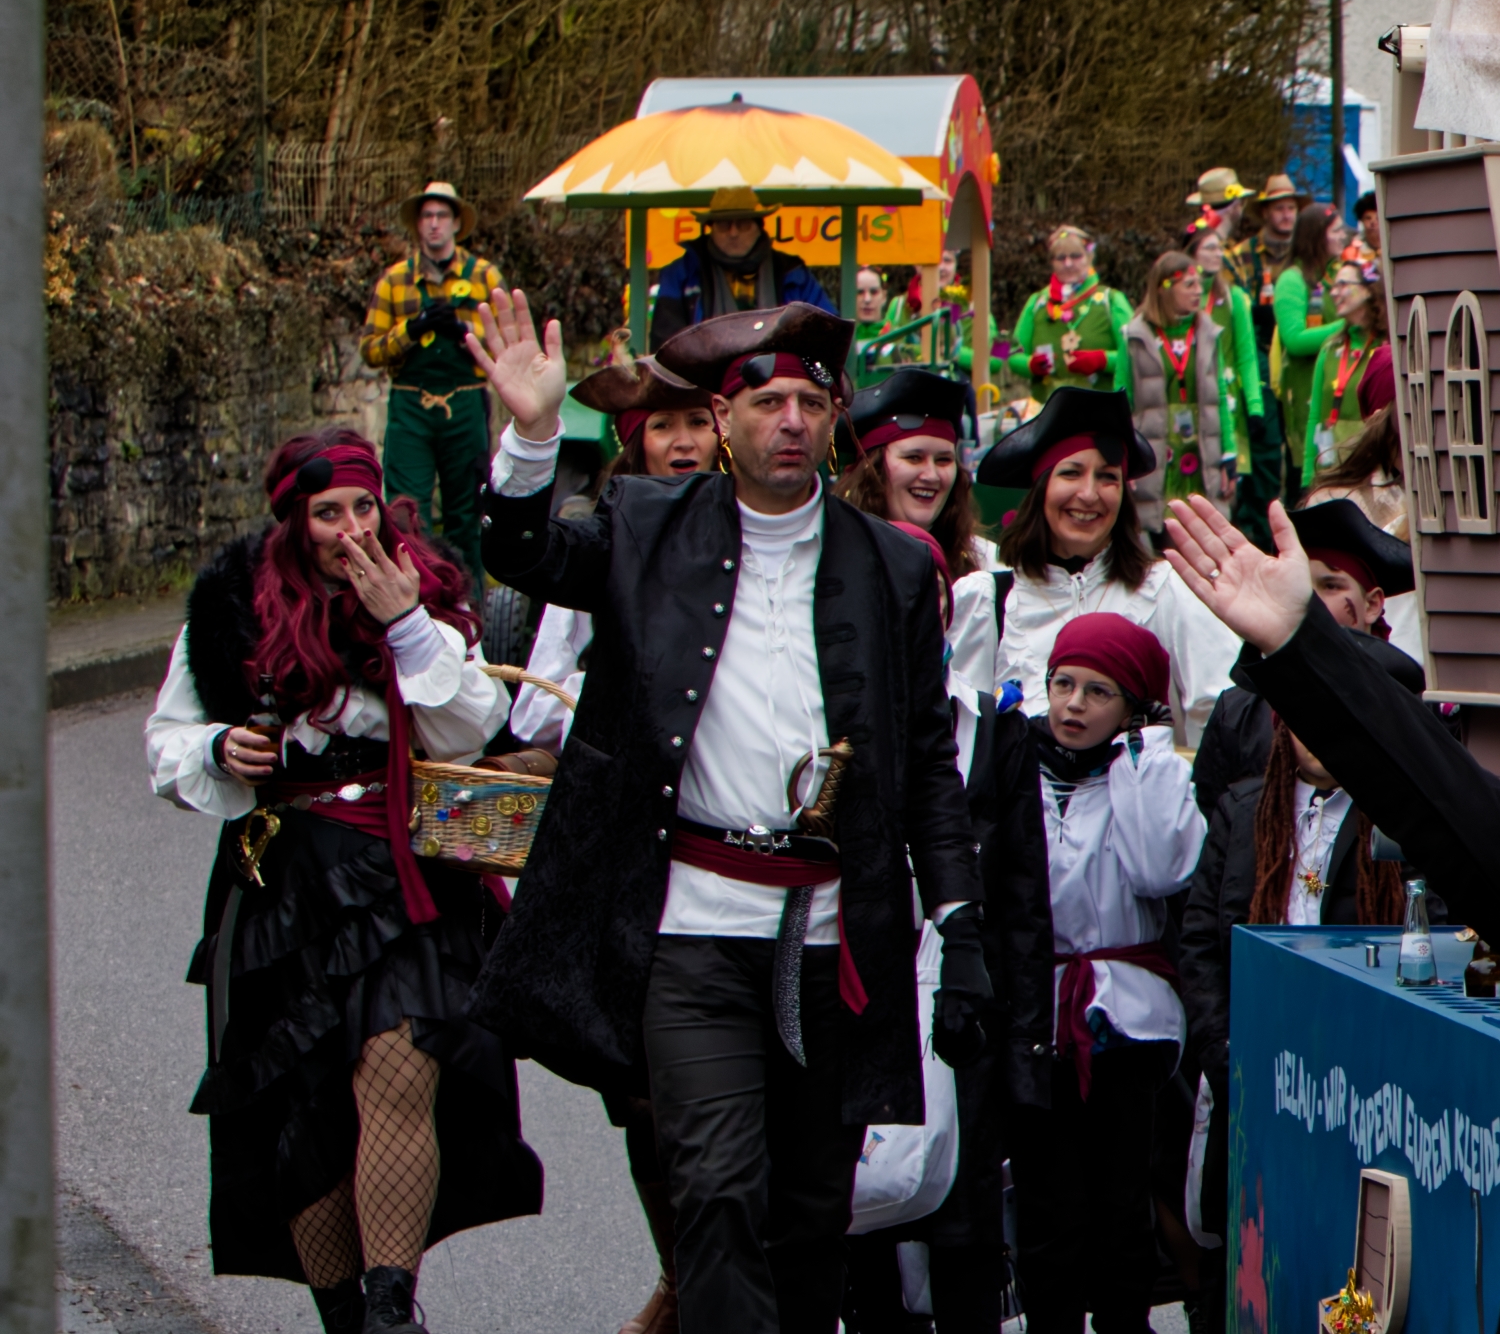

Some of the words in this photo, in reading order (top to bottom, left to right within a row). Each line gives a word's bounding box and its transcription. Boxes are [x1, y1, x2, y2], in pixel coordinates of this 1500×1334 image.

[1275, 1049, 1317, 1133] HELAU
[1323, 1066, 1346, 1132] WIR
[1349, 1082, 1402, 1165] KAPERN
[1405, 1093, 1451, 1193] EUREN
